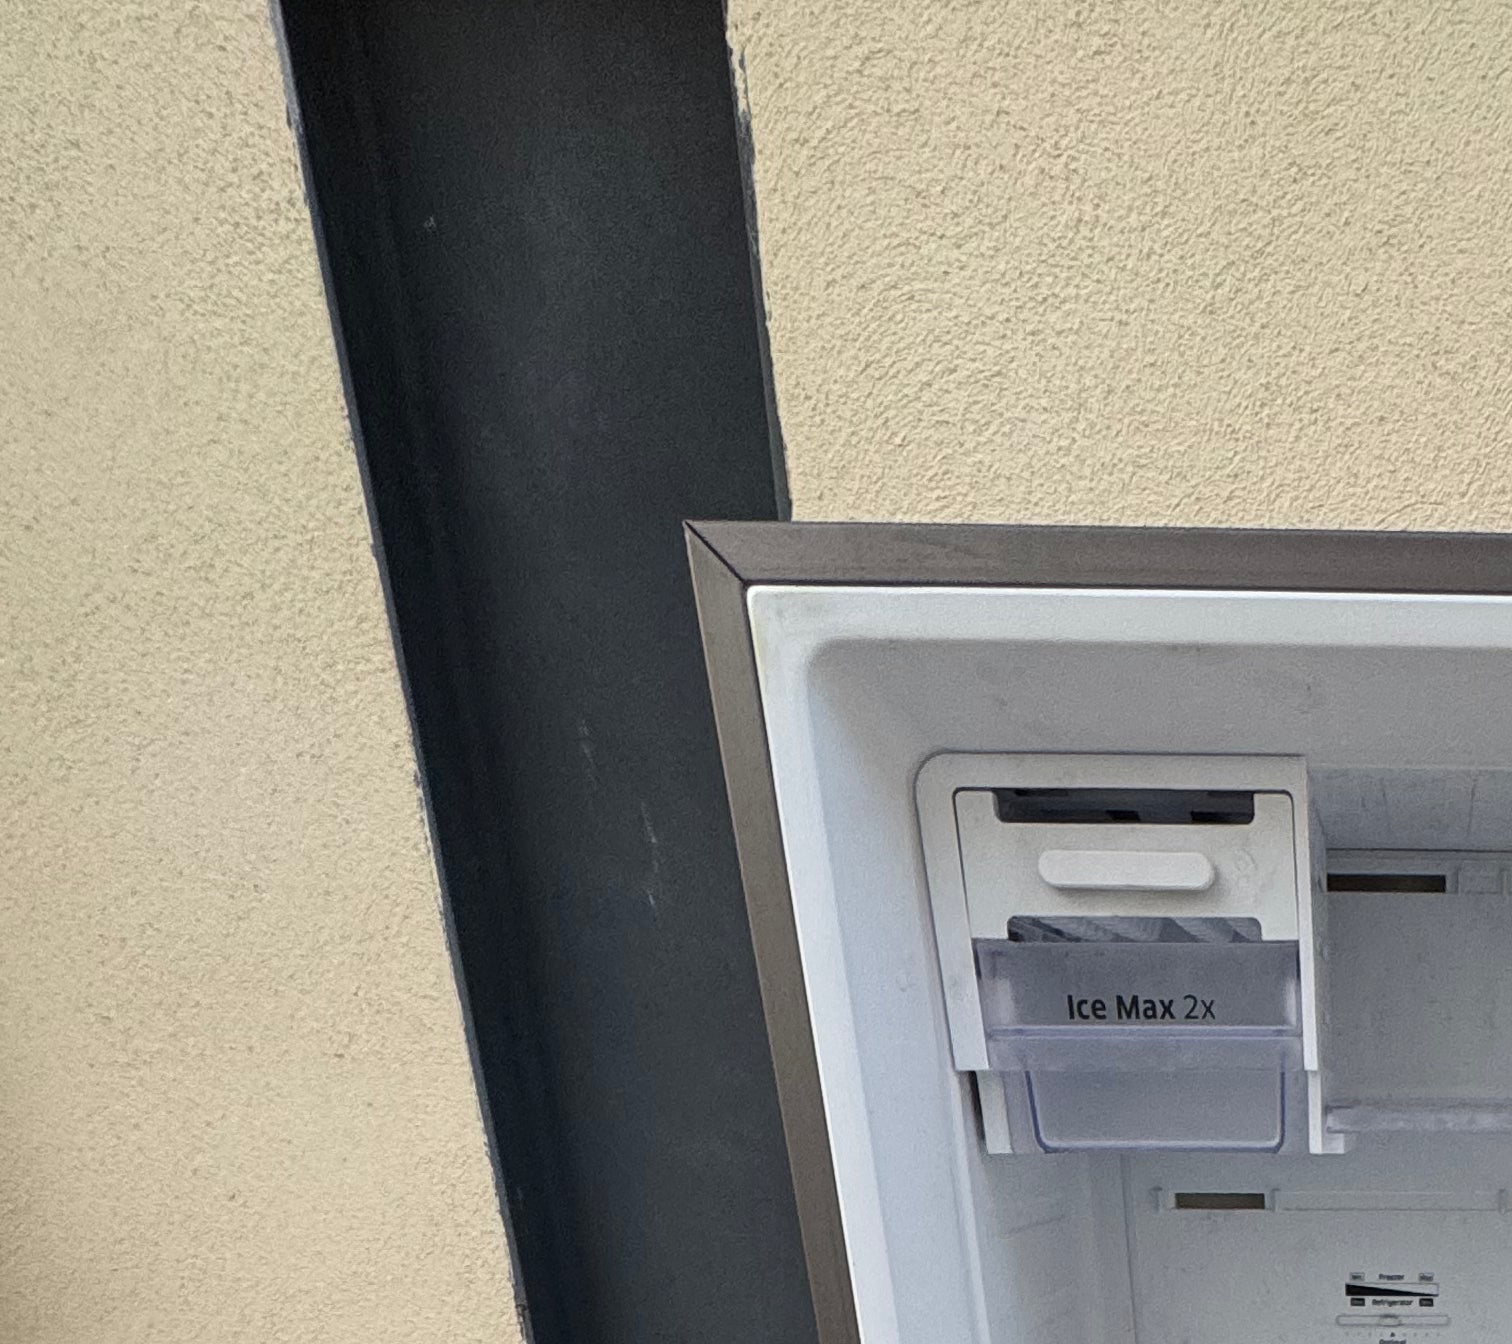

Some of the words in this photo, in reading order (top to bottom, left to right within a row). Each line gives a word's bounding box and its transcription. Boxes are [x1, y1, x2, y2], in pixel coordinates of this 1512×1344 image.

[1066, 994, 1107, 1020] Ice
[1115, 994, 1177, 1020] Max
[1183, 994, 1217, 1020] 2x
